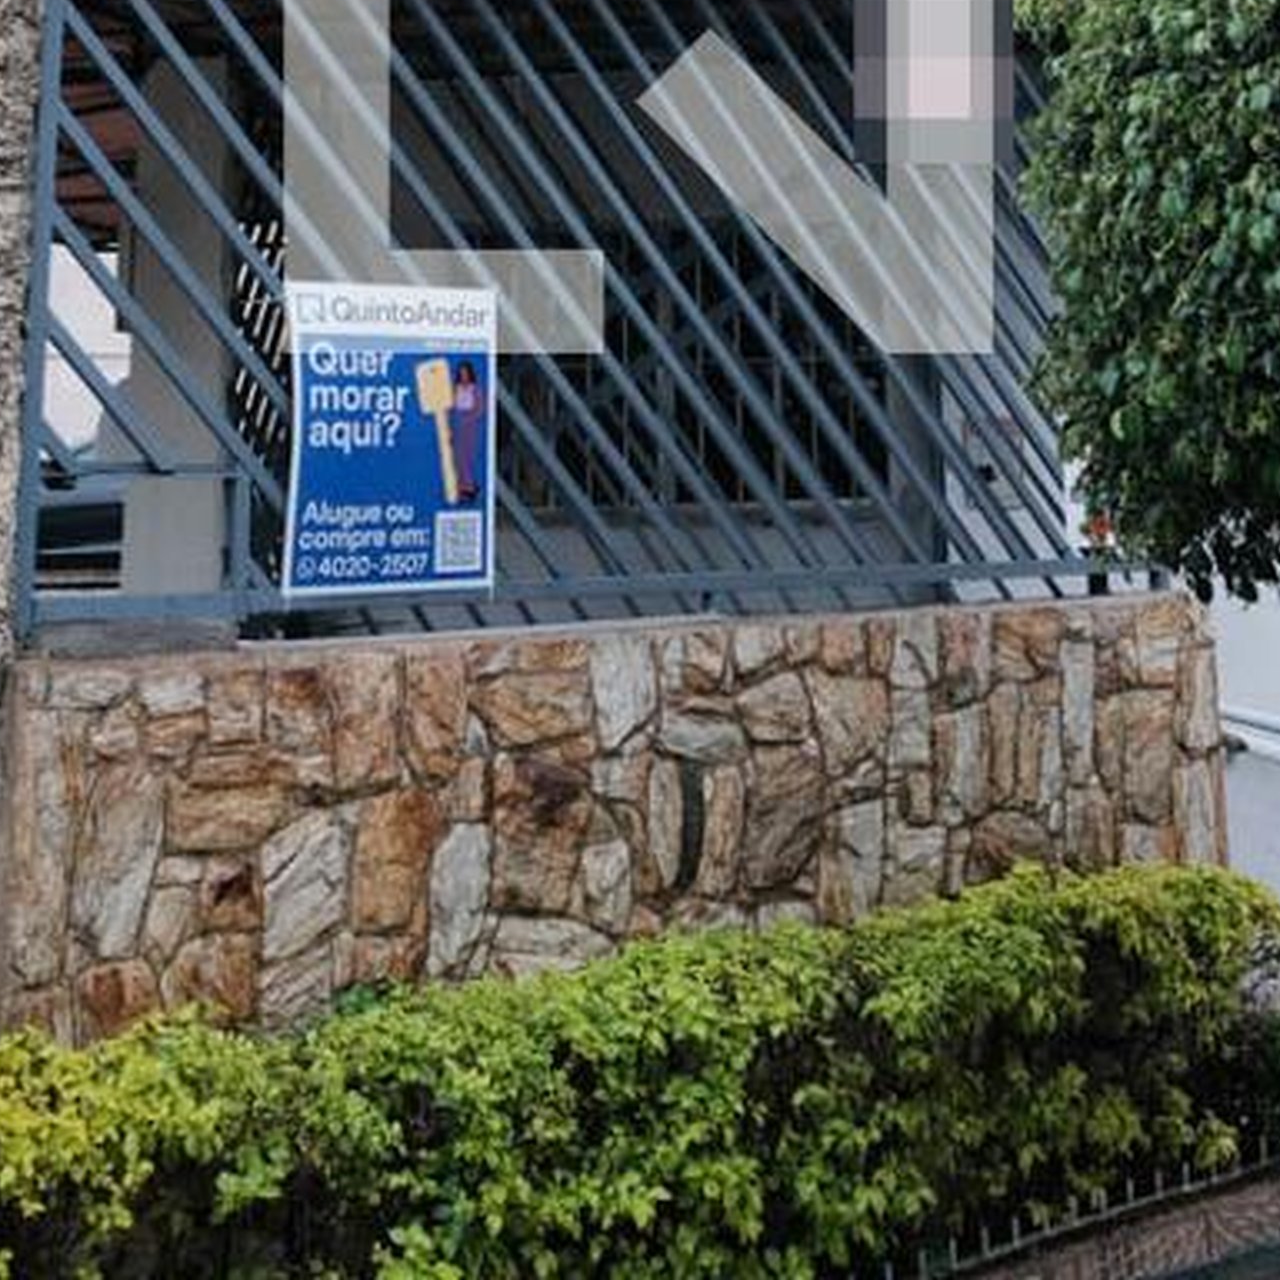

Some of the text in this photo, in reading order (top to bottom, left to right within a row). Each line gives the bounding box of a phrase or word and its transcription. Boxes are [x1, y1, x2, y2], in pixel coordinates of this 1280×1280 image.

[332, 295, 488, 327] QuintoAndar
[309, 342, 393, 377] Quer
[309, 384, 409, 412] morar
[309, 414, 401, 454] aqui?
[302, 501, 414, 527] Alugue ou
[298, 527, 430, 552] compre em:
